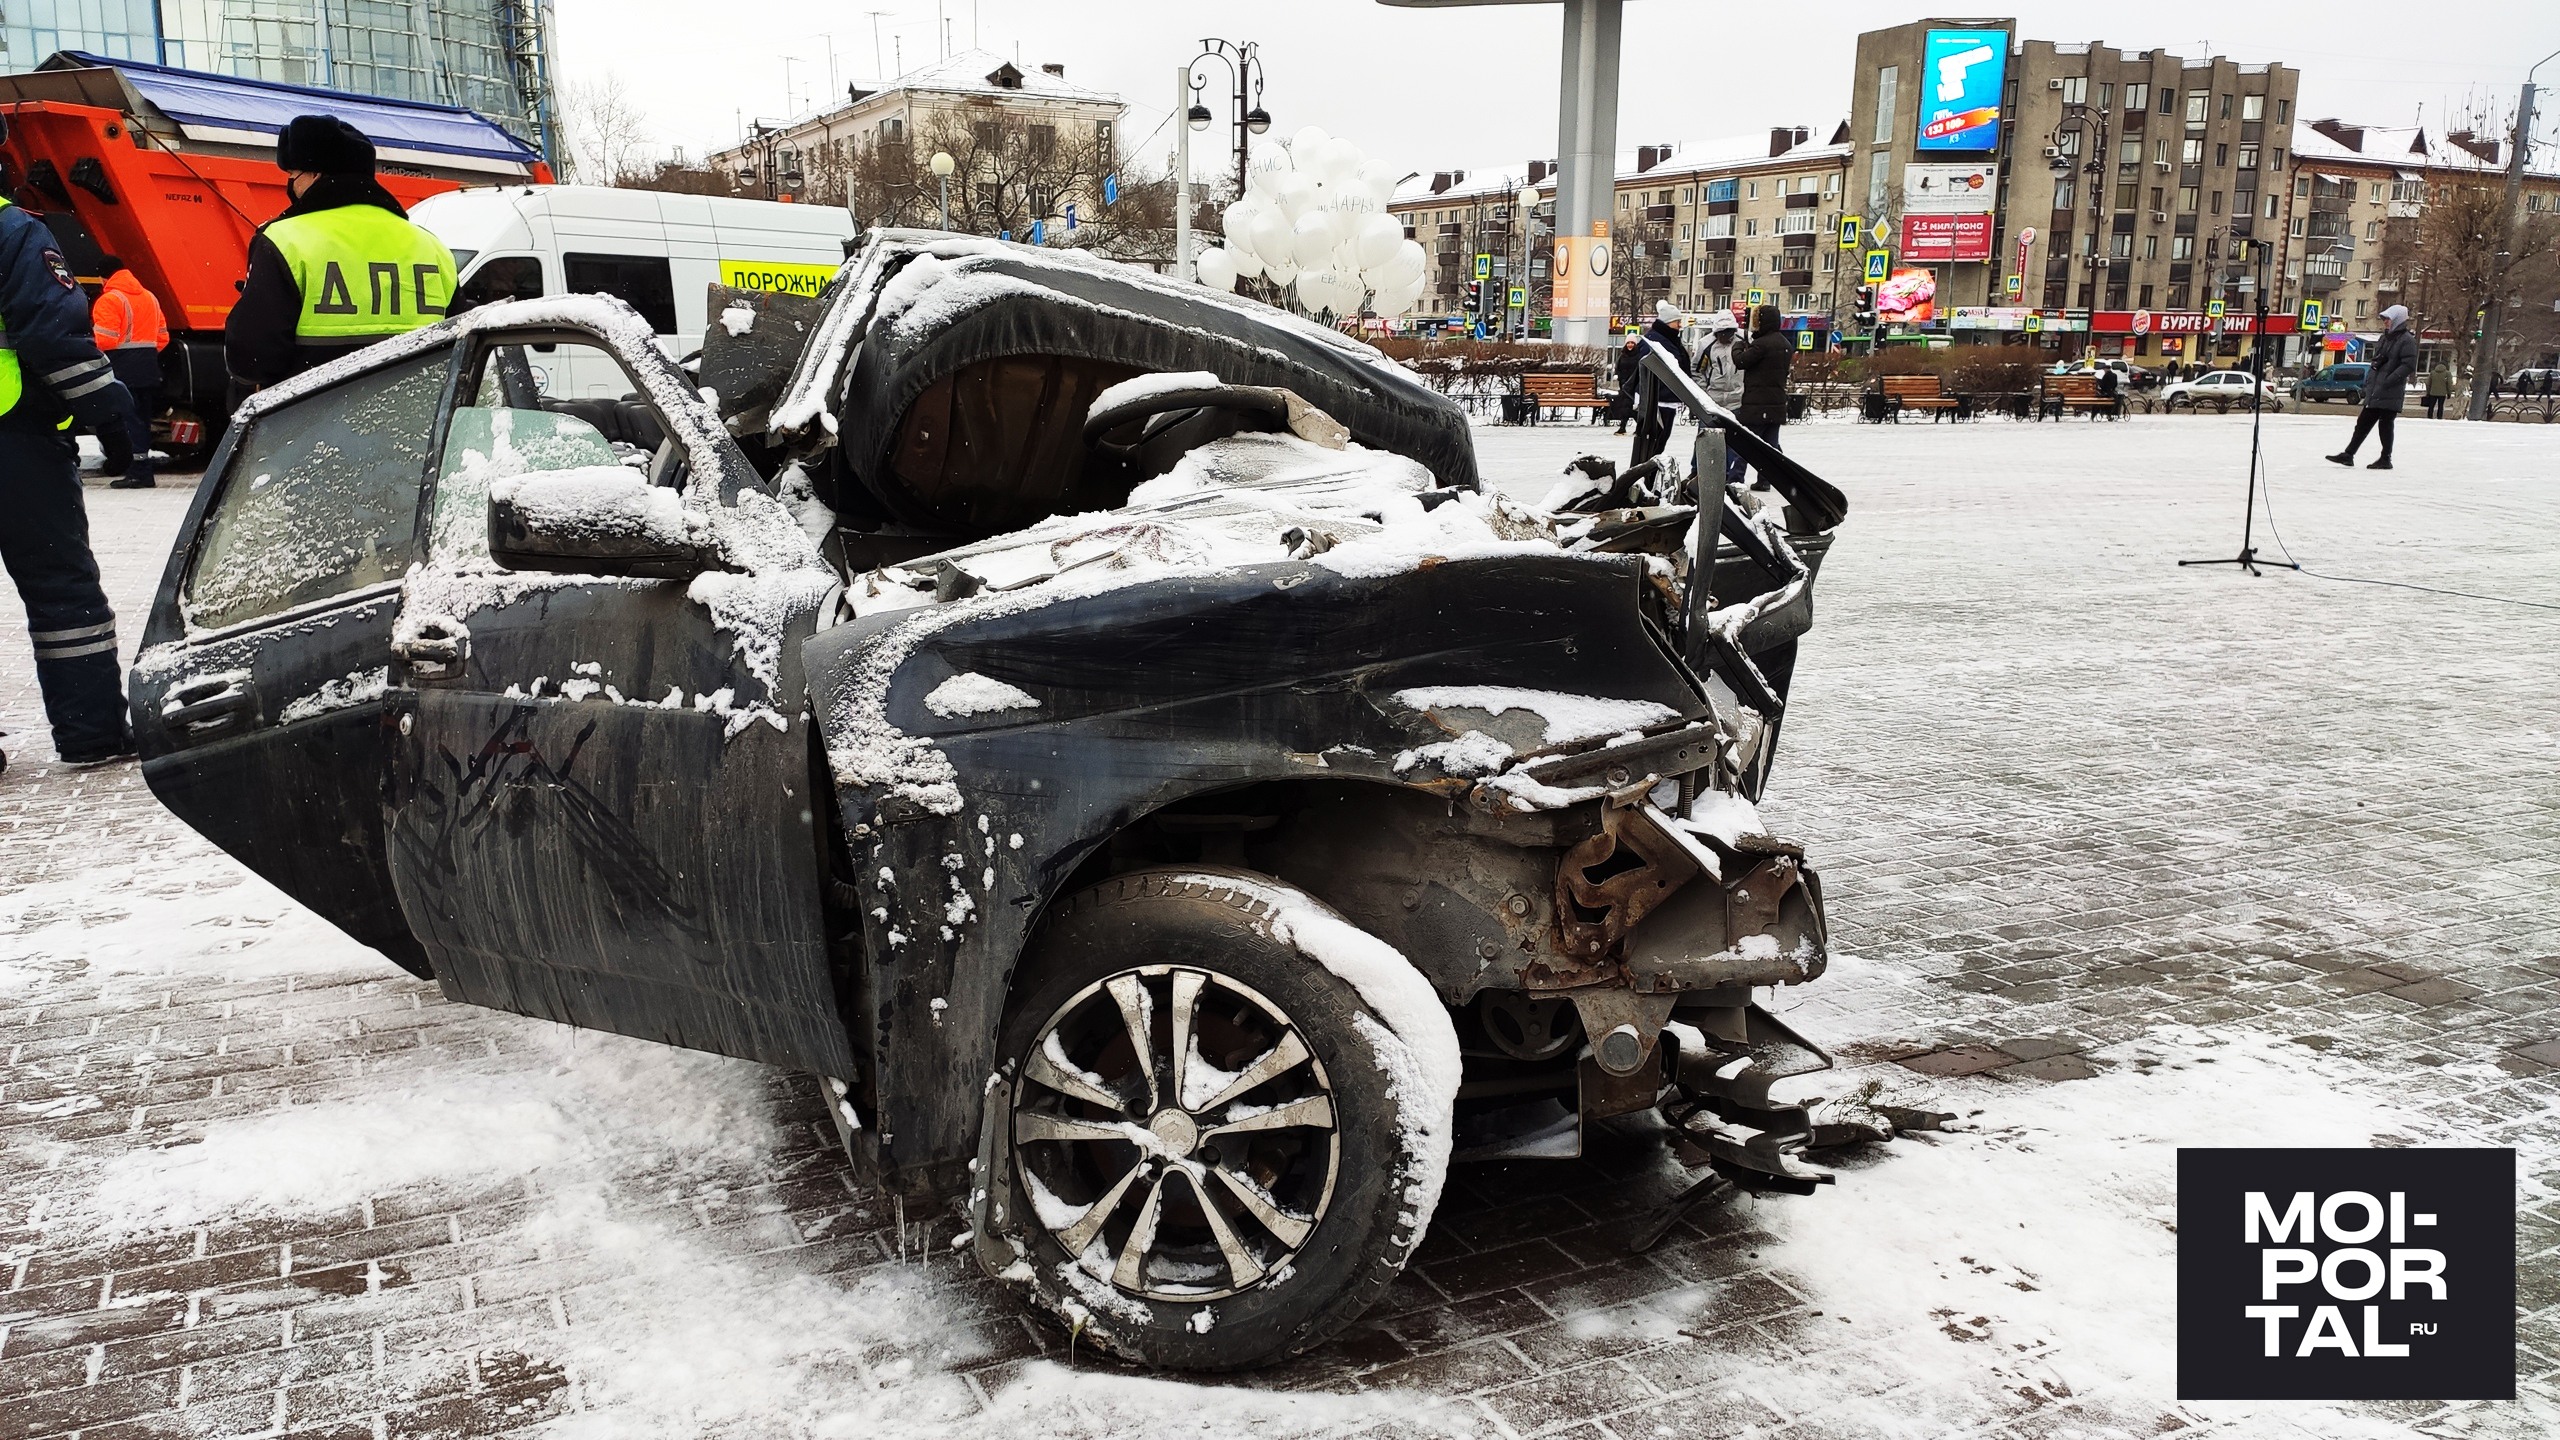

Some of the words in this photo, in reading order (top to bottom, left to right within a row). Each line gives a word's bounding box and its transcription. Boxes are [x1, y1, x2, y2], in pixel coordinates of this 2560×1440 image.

[1912, 220, 1928, 231] 2,5
[1929, 222, 1984, 230] миллиона
[314, 261, 445, 315] ДПС
[2160, 315, 2211, 331] БУРГЕР
[2222, 316, 2253, 332] ИНГ
